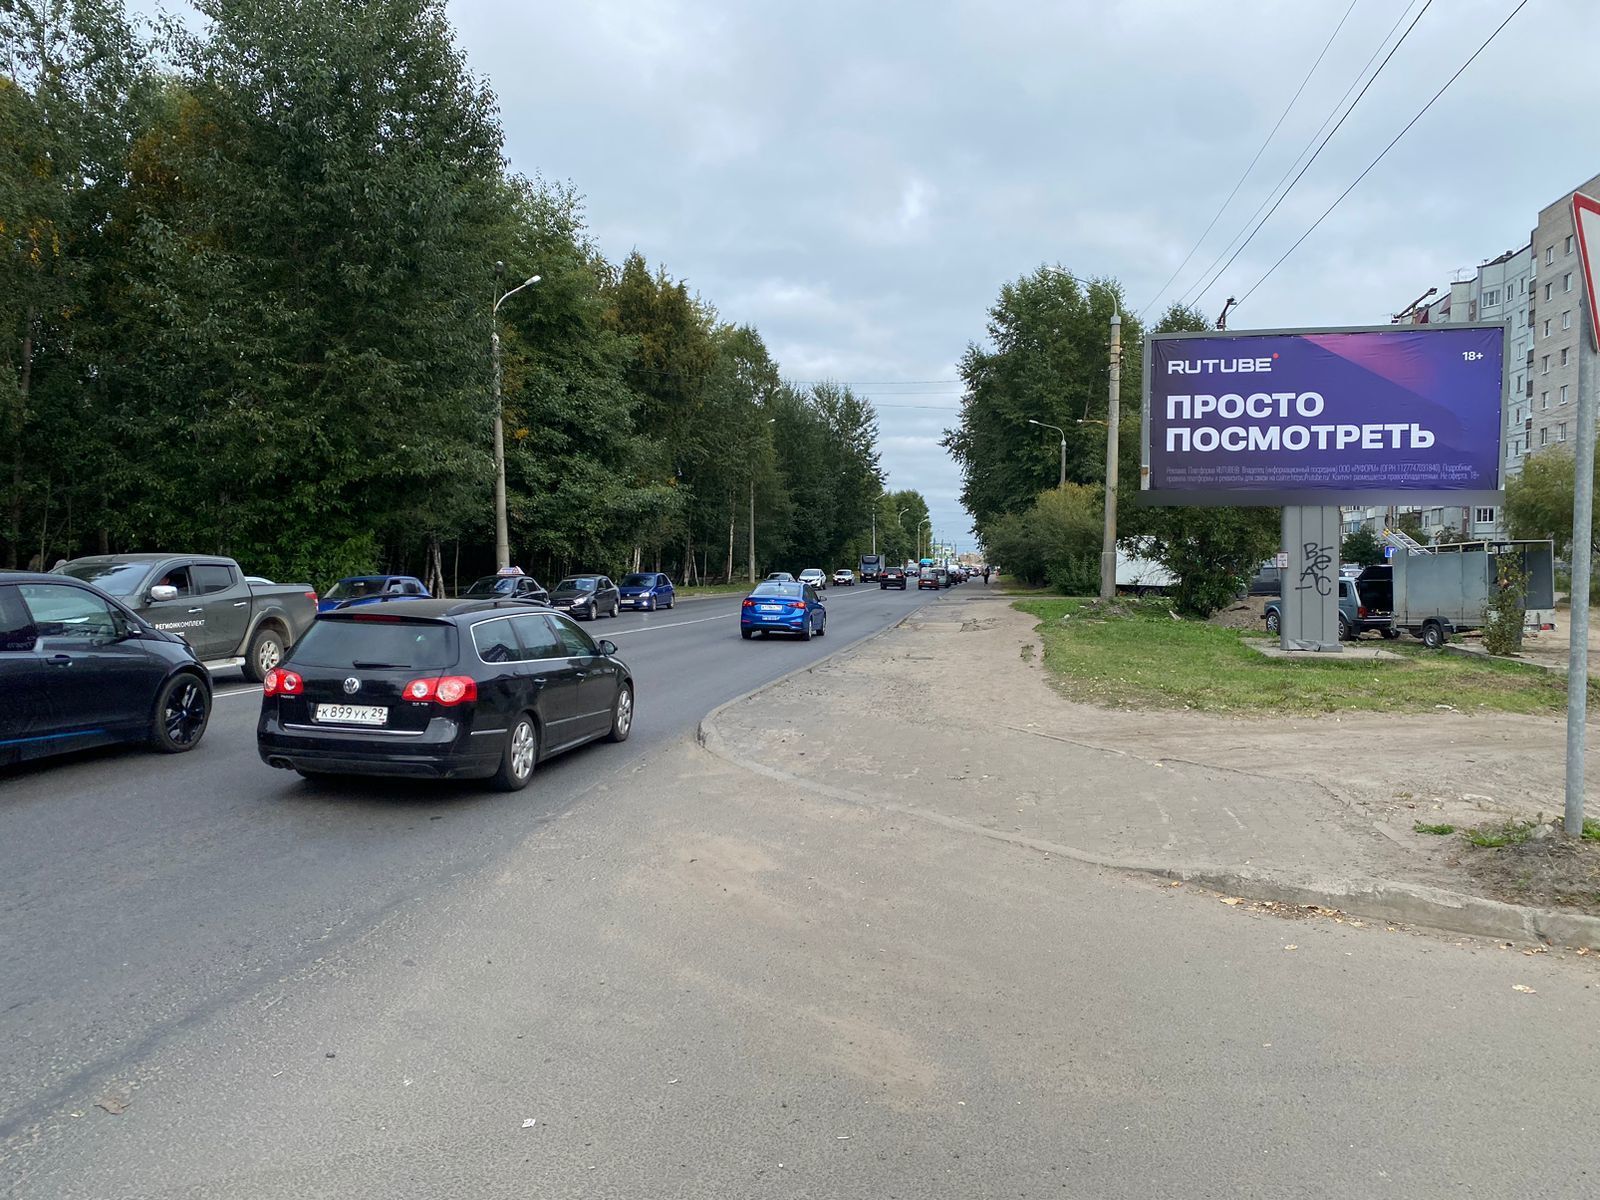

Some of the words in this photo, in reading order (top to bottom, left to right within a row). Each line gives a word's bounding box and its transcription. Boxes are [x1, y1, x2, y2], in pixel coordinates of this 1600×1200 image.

[1168, 357, 1272, 375] RUTUBE
[1462, 351, 1484, 361] 18+
[1166, 391, 1325, 420] ПРОСТО
[1165, 423, 1435, 452] ПОСМОТРЕТЬ
